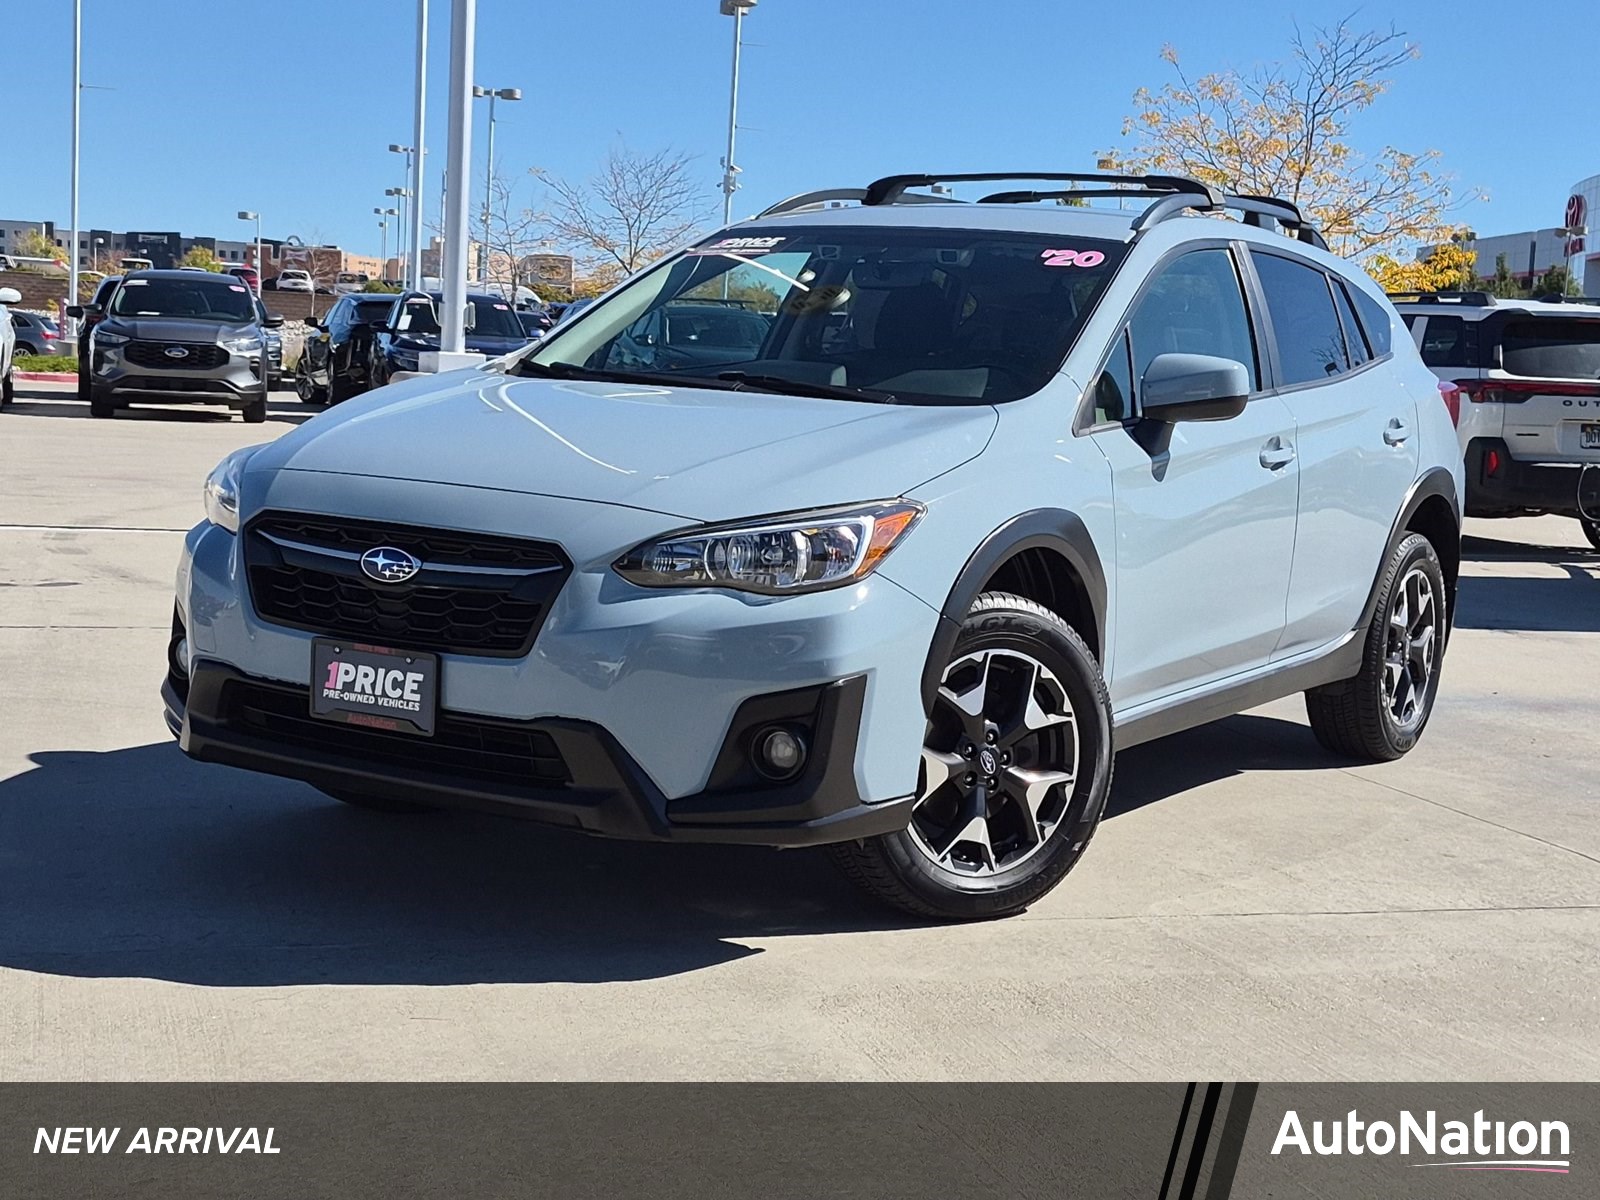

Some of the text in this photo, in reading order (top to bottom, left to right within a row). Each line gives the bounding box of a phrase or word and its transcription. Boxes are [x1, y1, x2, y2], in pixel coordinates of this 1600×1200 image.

[324, 661, 424, 701] 1PRICE
[322, 688, 420, 711] PRE-OWNED VEHICLES
